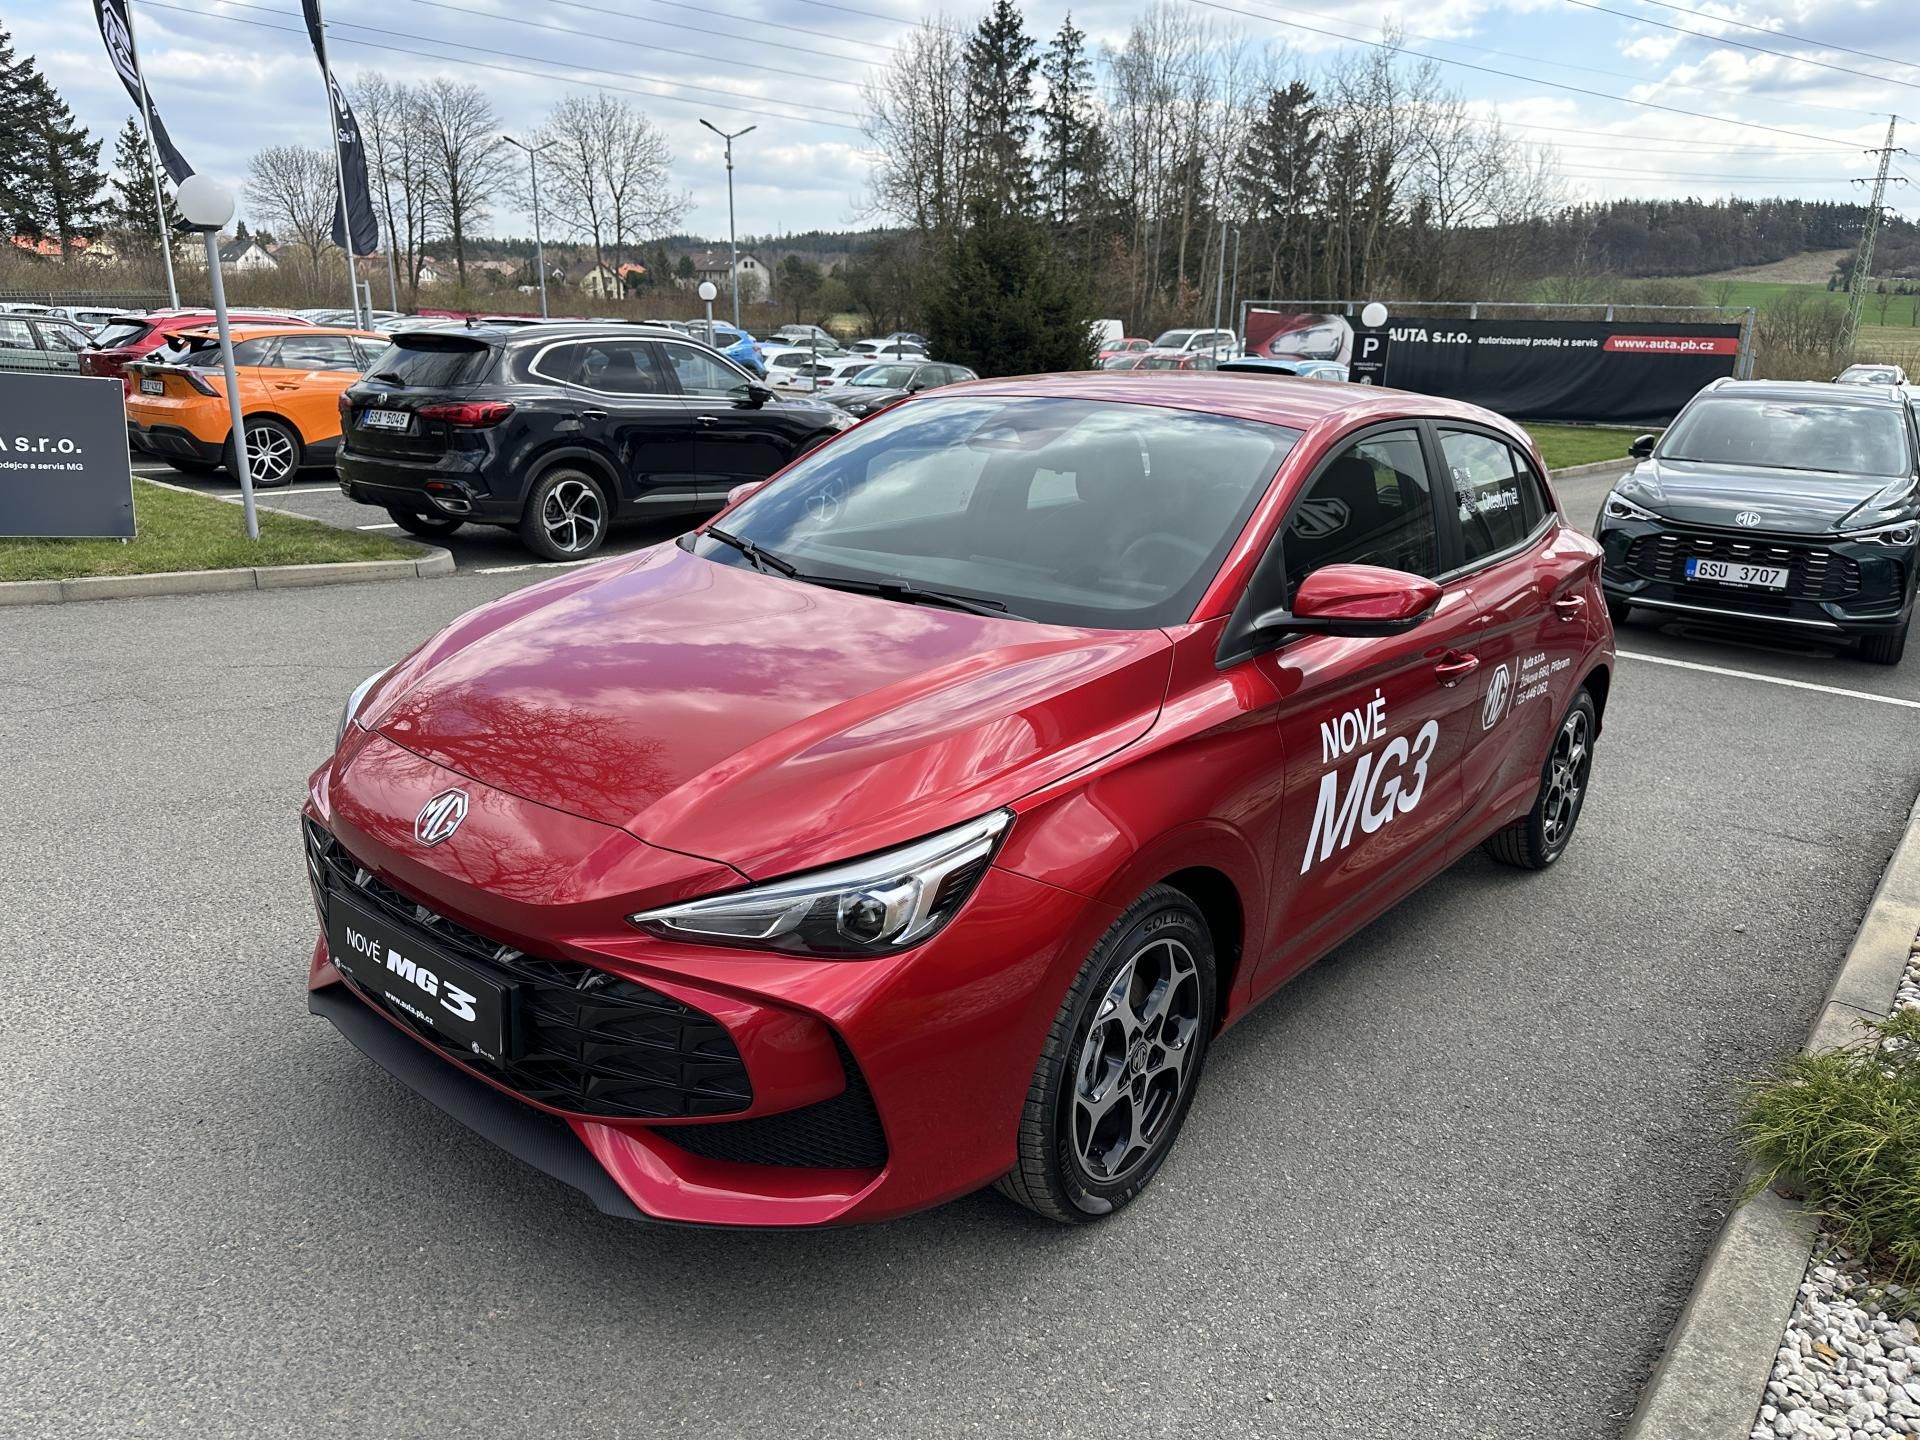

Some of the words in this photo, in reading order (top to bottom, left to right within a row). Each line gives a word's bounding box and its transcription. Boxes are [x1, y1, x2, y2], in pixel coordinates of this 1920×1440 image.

[1362, 337, 1379, 358] P
[1388, 327, 1428, 342] AUTA
[1432, 331, 1472, 344] s.r.o.
[1478, 336, 1531, 347] autorizovaný
[1532, 338, 1562, 348] prodej
[1562, 339, 1569, 347] a
[1571, 338, 1598, 348] servis
[1614, 340, 1715, 351] www.auta.pb.cz
[15, 437, 82, 453] s.r.o.
[38, 463, 65, 471] servis
[66, 463, 84, 471] MG
[1737, 512, 1759, 526] MG
[1699, 562, 1728, 578] 6SU
[1739, 567, 1780, 584] 3707
[1484, 668, 1508, 726] MG
[1320, 688, 1387, 764] NOVÉ
[1300, 719, 1439, 876] MG3
[417, 791, 467, 843] MG
[346, 926, 381, 964] NOVÉ
[384, 990, 434, 1025] www.auta.pb.cz
